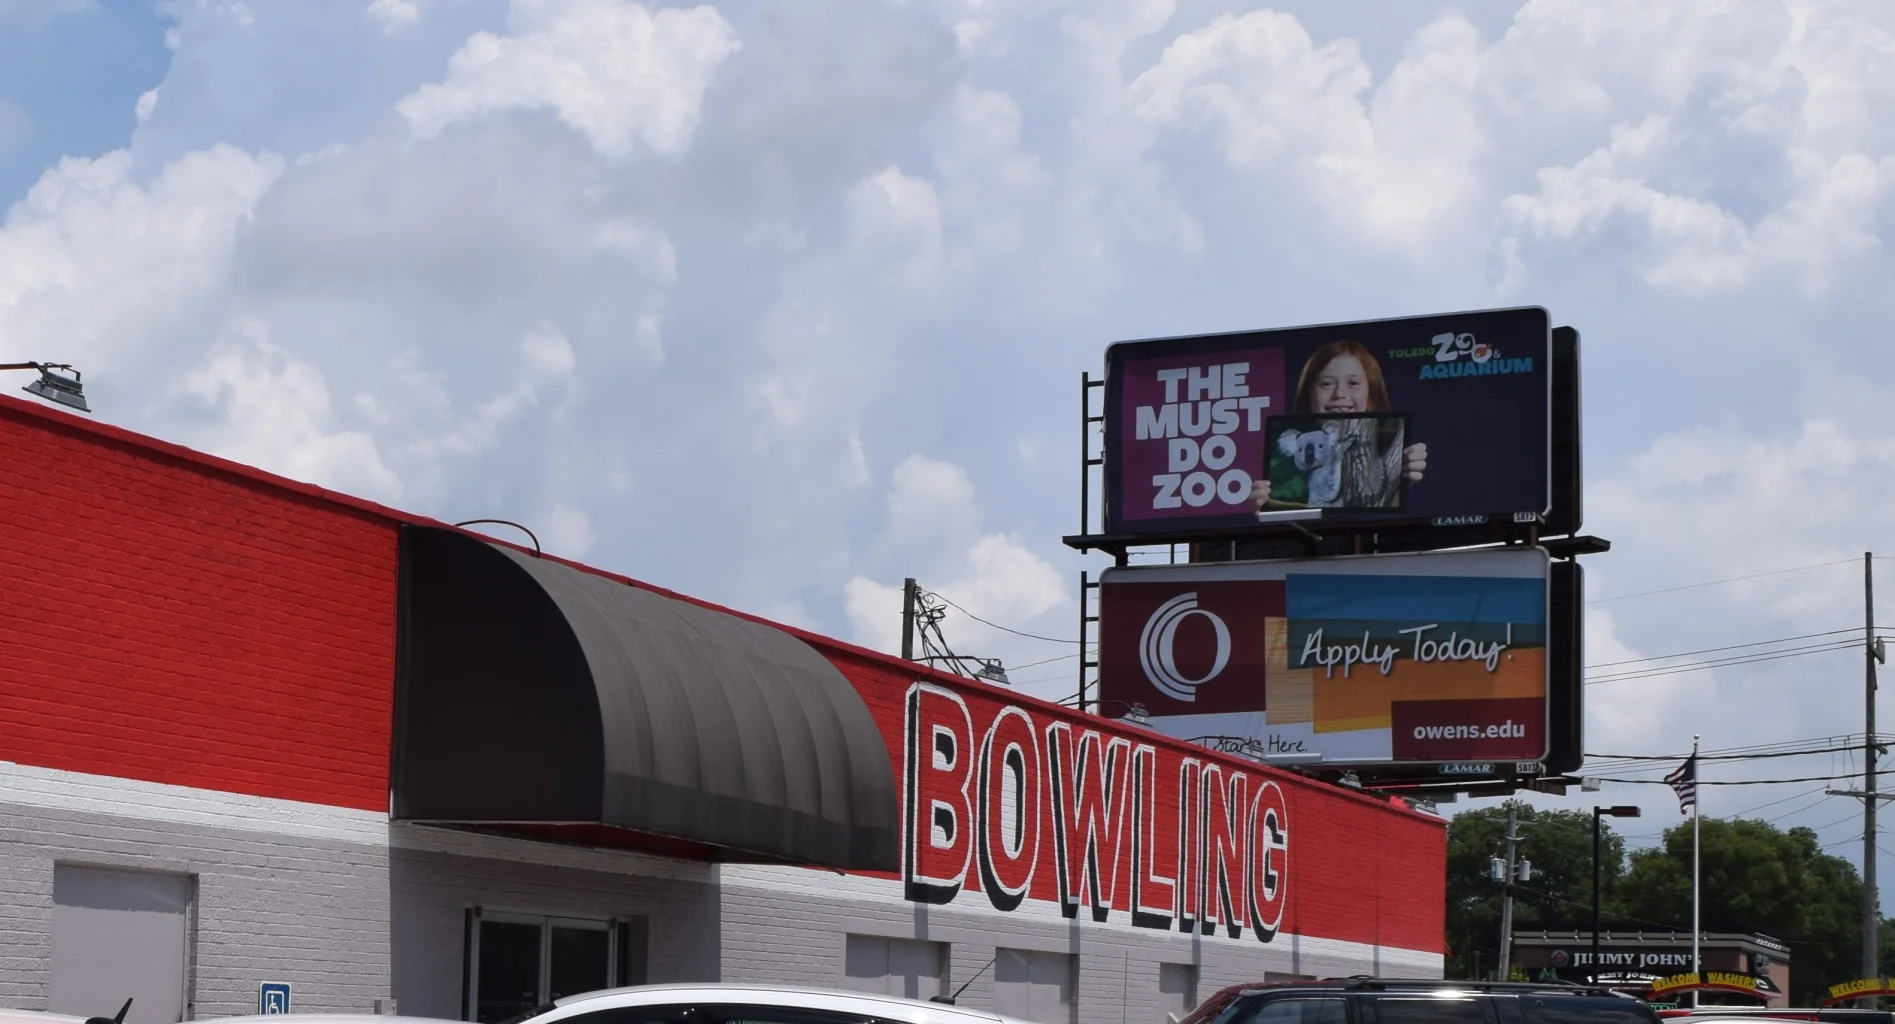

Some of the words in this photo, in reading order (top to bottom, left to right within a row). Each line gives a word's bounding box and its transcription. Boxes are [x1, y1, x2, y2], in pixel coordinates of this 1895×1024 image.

[1388, 347, 1436, 359] TOLEDO
[1493, 349, 1502, 358] &
[1419, 357, 1533, 380] AQUARIUM
[1157, 362, 1250, 403] THE
[1135, 396, 1270, 441] MUST
[1168, 434, 1237, 473] DO
[1152, 469, 1253, 510] ZOO
[1437, 515, 1484, 525] LAMAR
[1300, 628, 1400, 678] Apply
[1398, 622, 1512, 672] Today!
[1413, 719, 1525, 740] owens.edu
[1269, 734, 1308, 753] Here.
[1444, 763, 1491, 773] LAMAR
[901, 681, 1288, 943] BOWLING
[1652, 972, 1700, 992] WELCOME
[1707, 972, 1757, 990] WASHERS
[1828, 978, 1881, 998] WELCOME
